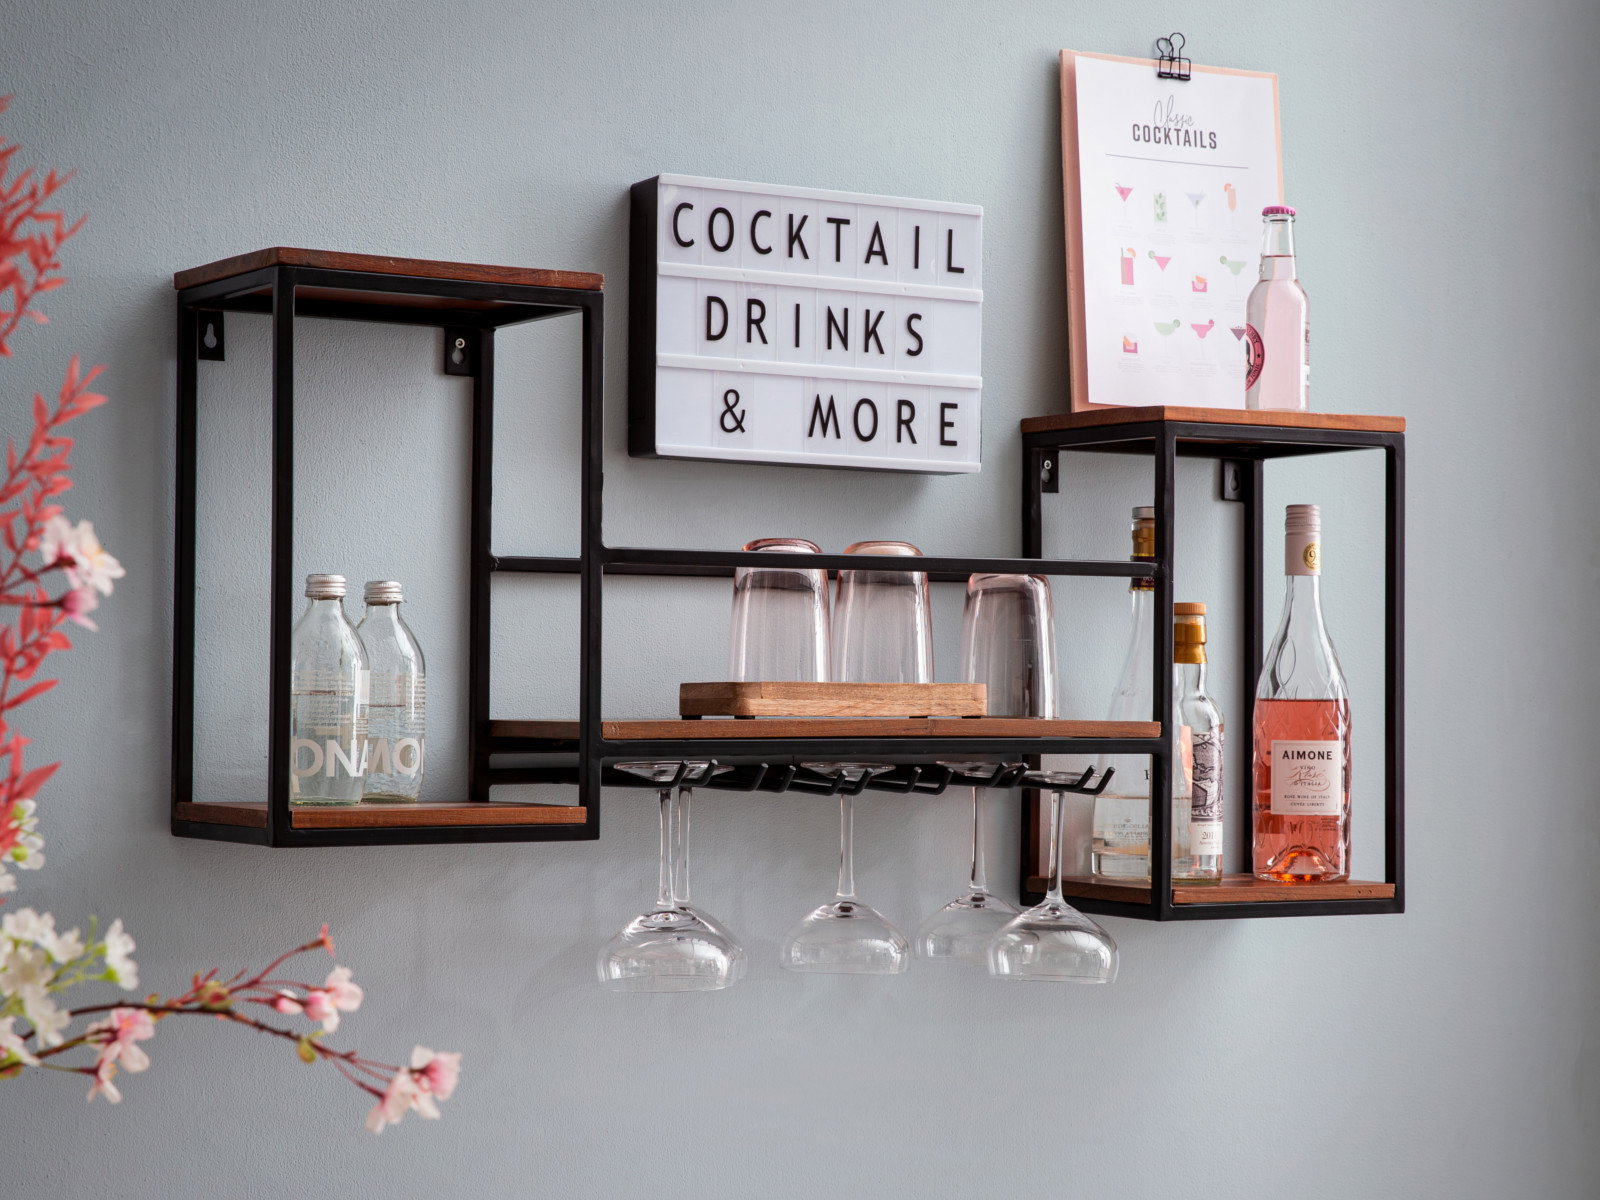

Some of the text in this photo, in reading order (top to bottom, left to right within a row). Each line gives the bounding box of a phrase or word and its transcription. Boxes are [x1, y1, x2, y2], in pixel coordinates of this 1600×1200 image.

[1153, 94, 1195, 128] Classic
[1132, 123, 1217, 150] COCKTAILS
[672, 202, 965, 275] COCKTAIL
[706, 295, 924, 357] DRINKS
[719, 388, 958, 447] & MORE
[1282, 750, 1333, 761] AIMONE
